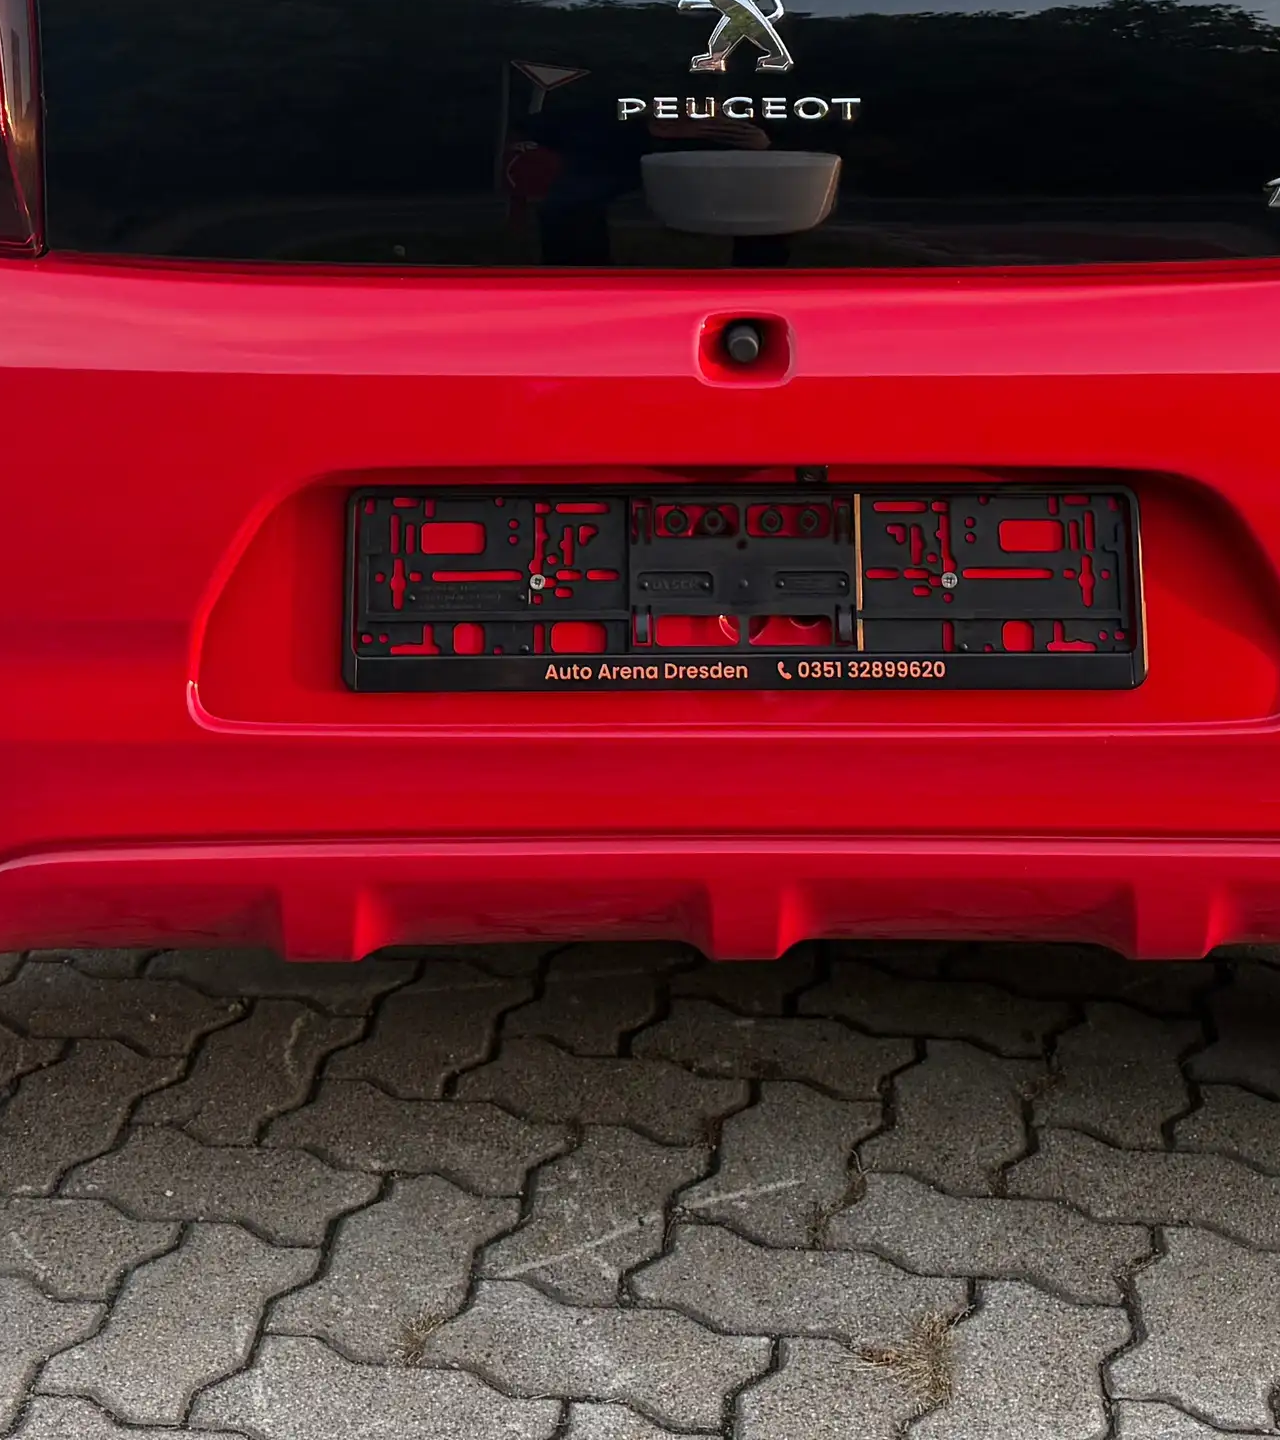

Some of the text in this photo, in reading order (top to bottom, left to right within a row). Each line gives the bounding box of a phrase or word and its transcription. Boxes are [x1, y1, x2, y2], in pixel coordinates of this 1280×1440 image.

[617, 96, 862, 120] PEUGEOT
[545, 661, 946, 680] Auto Arena Dresden 0351 32899620
